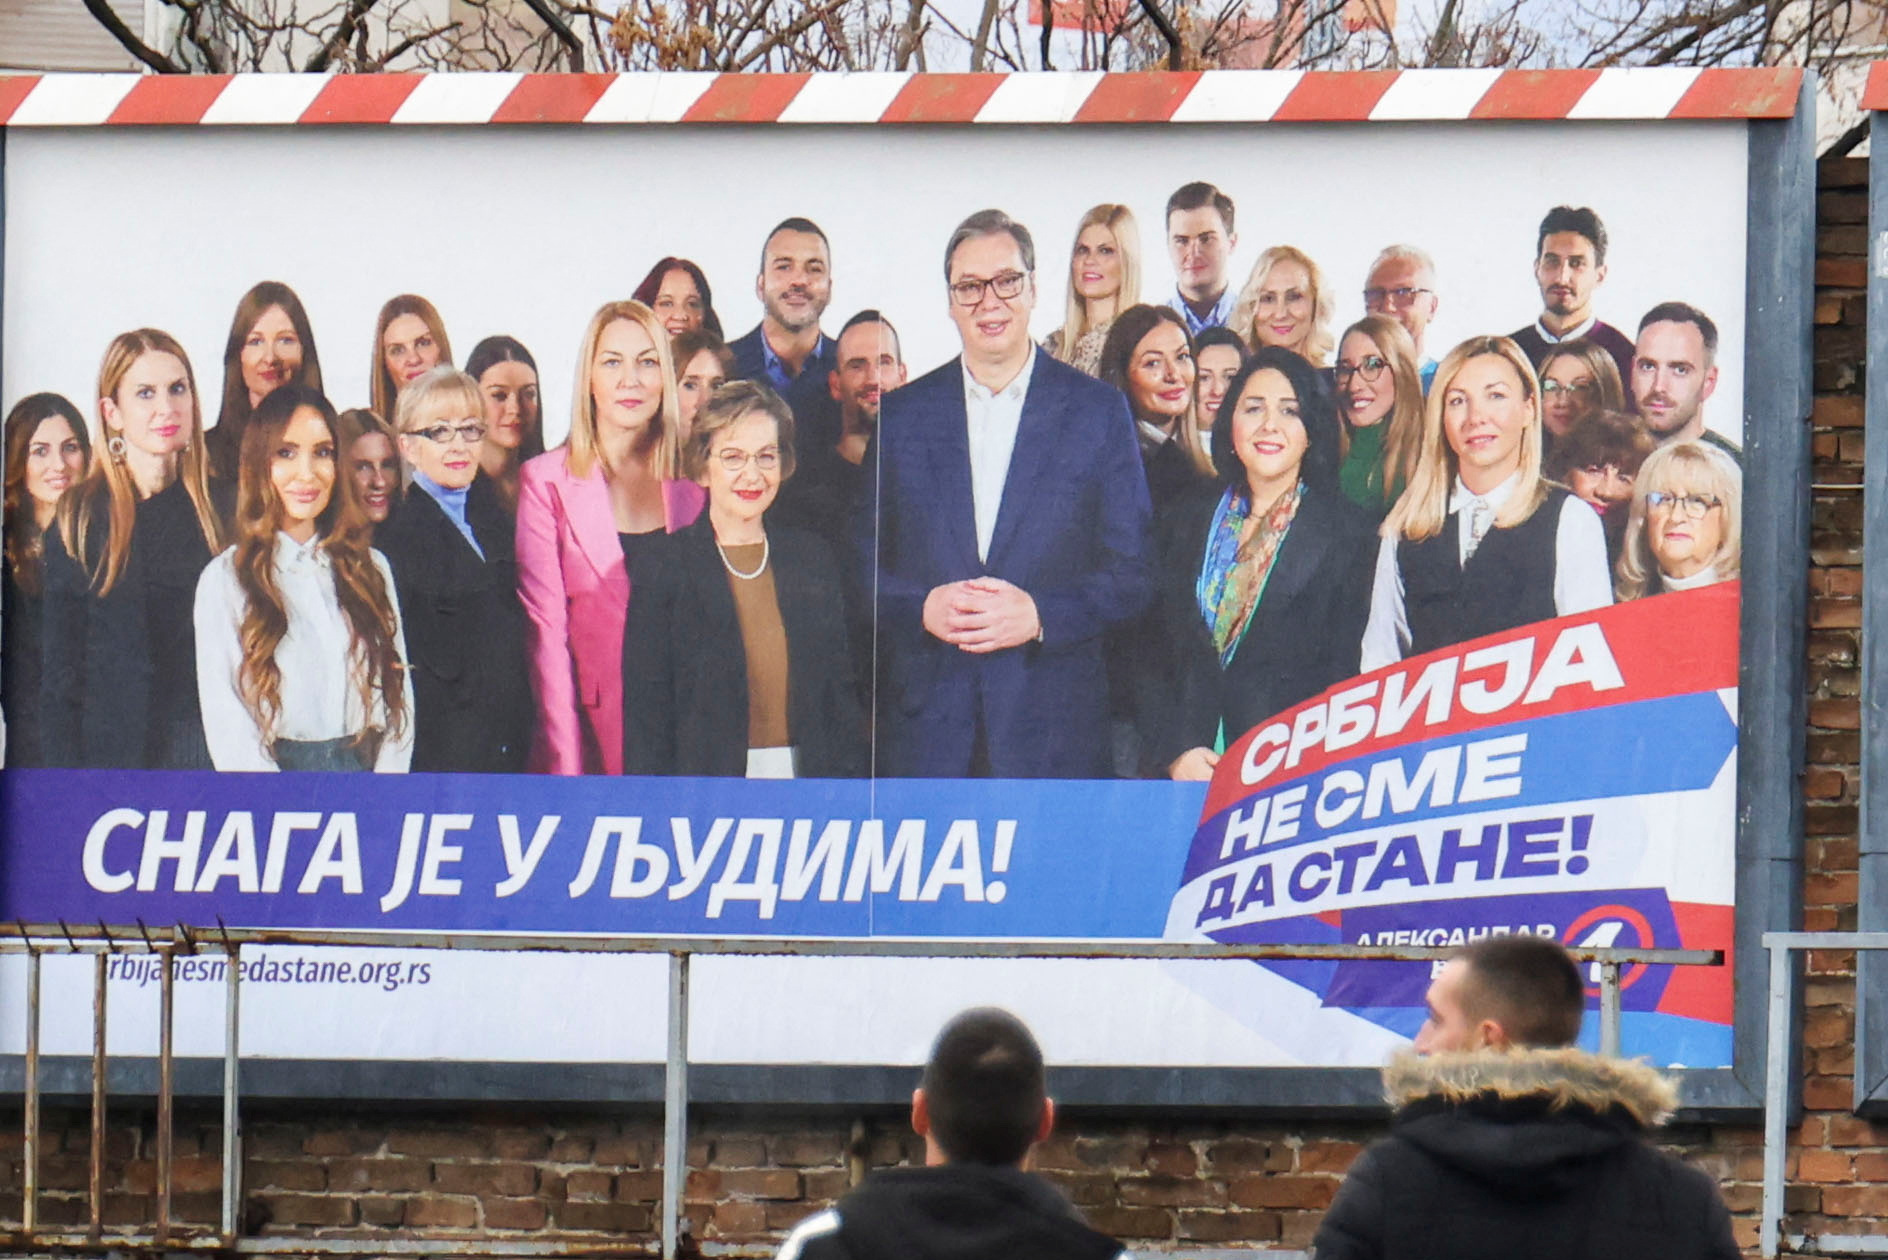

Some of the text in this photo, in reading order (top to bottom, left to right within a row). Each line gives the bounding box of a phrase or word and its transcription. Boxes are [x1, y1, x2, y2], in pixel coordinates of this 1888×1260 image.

[1240, 622, 1625, 786] СРБИЈА
[1219, 733, 1528, 861] НЕ СМЕ
[82, 807, 1018, 920] СНАГА ЈЕ У ЉУДИМА!
[1195, 814, 1594, 930] ДА СТАНЕ!
[106, 953, 432, 993] rbijanesmedastane.org.rs
